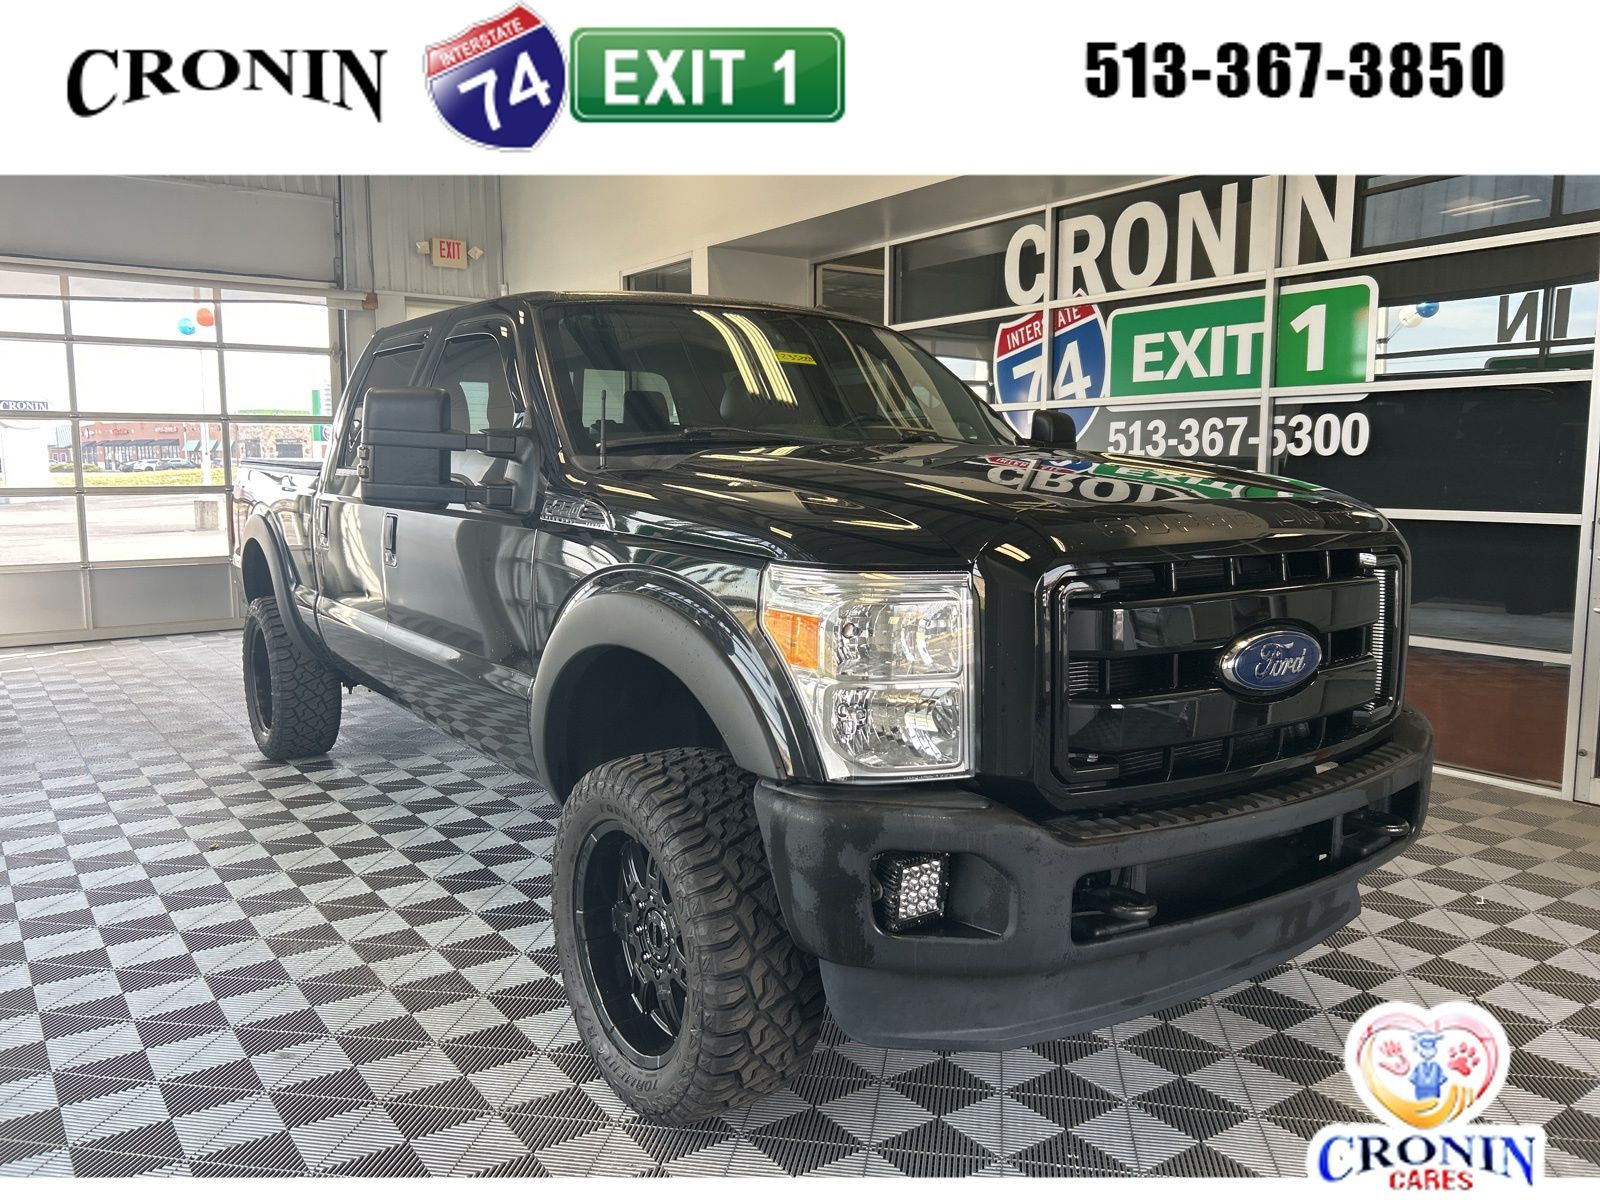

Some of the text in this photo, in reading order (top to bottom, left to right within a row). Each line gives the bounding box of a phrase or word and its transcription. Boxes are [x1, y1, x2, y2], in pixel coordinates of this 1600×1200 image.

[439, 240, 461, 259] EXIT
[1004, 175, 1356, 305] CRONIN
[1006, 306, 1082, 350] INTERATE
[1132, 304, 1327, 383] EXIT 1
[1012, 339, 1092, 403] 74
[1, 401, 48, 411] CRONIN
[1107, 411, 1370, 458] 513-367-5300
[1254, 641, 1307, 680] Ford
